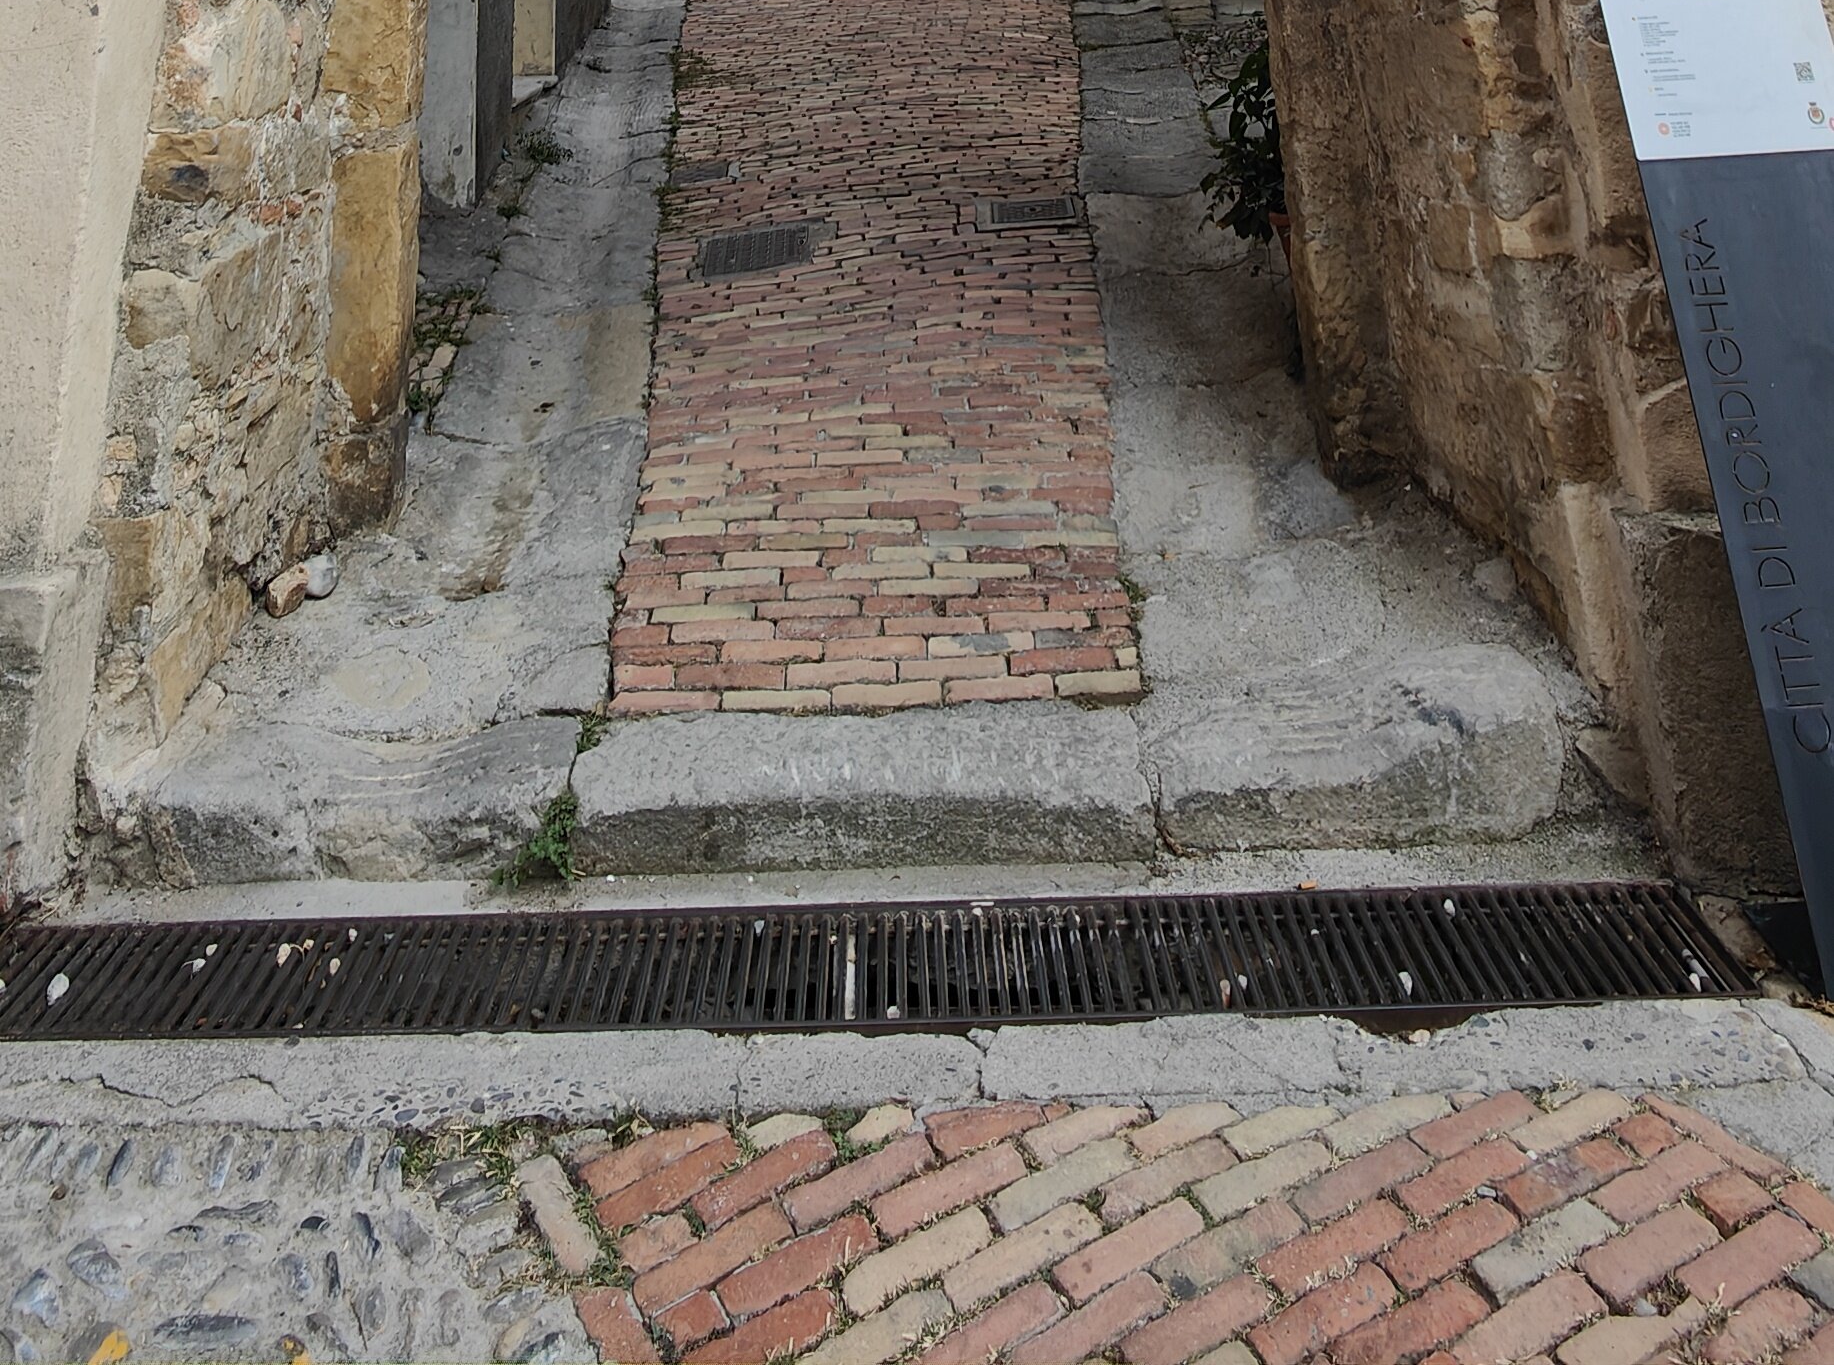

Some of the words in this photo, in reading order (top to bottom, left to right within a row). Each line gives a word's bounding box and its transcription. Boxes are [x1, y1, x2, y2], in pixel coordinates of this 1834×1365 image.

[1680, 218, 1781, 525] BORDIGHERA
[1751, 546, 1796, 589] DI
[1760, 608, 1832, 753] CITTÀ
